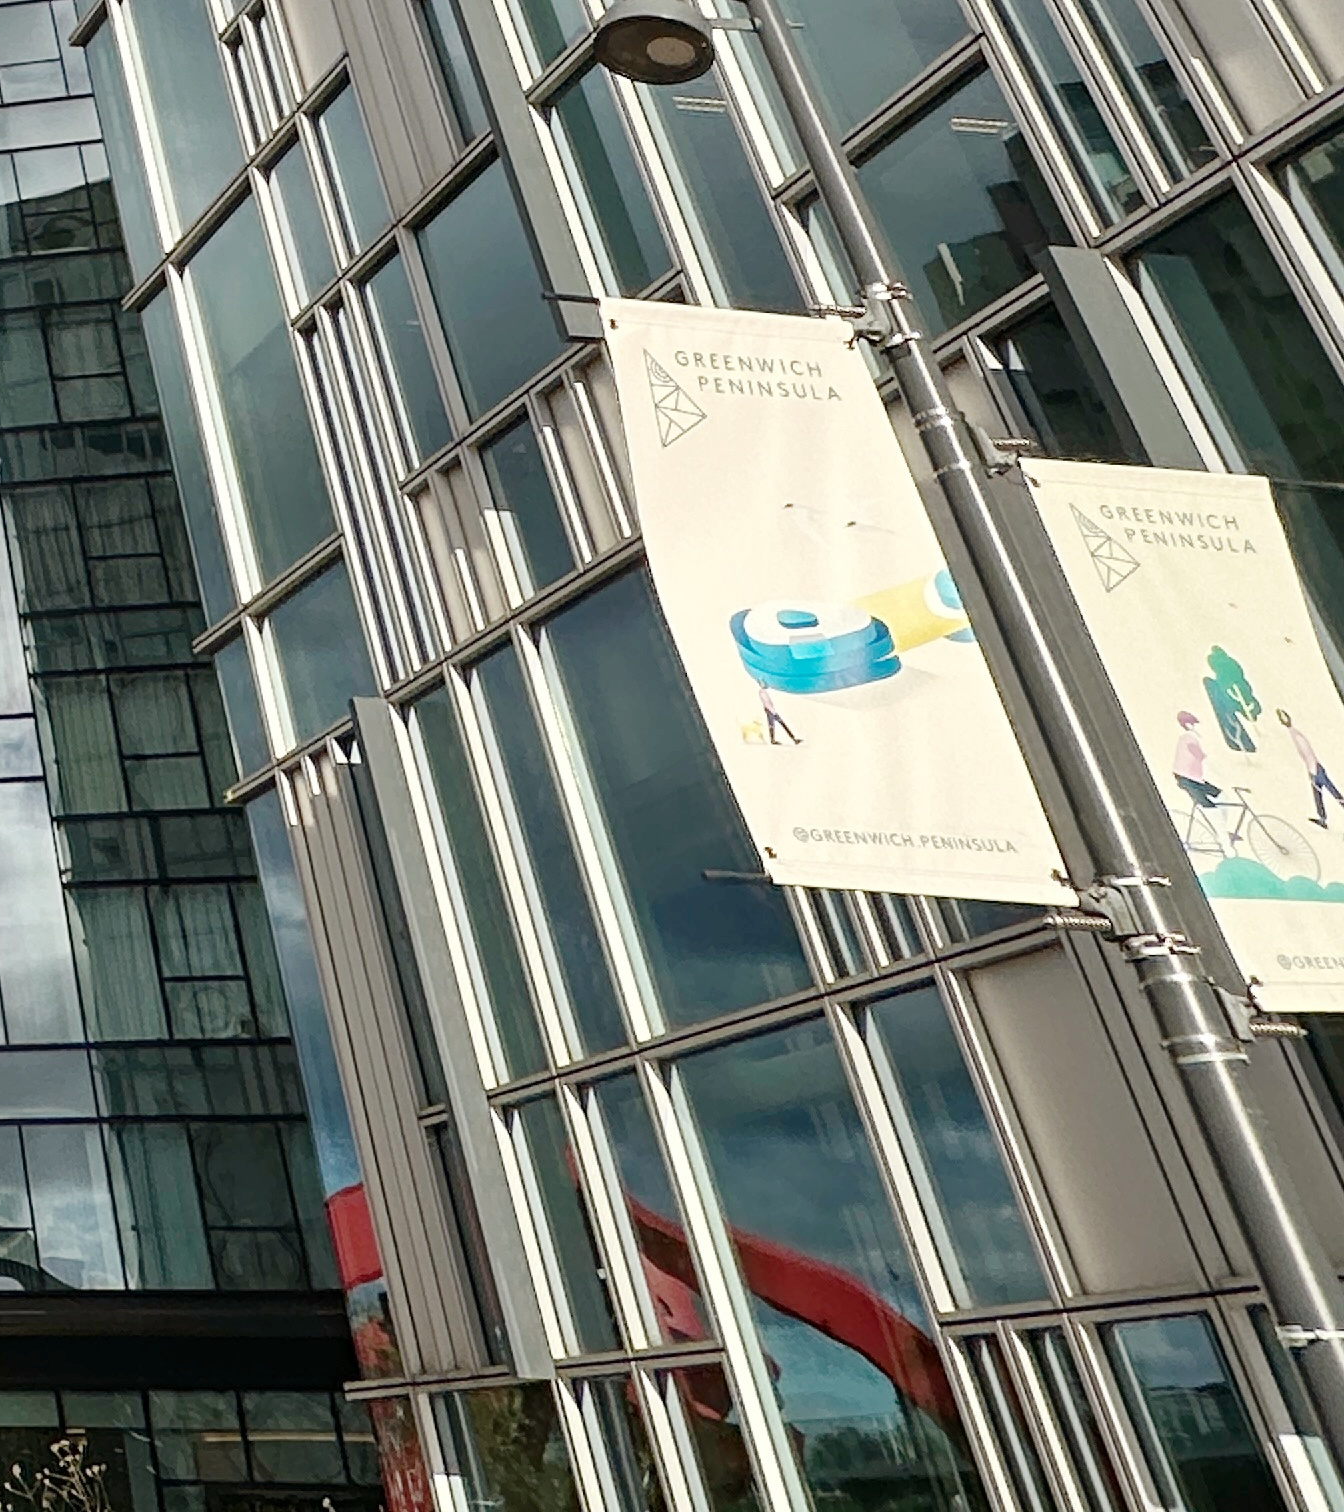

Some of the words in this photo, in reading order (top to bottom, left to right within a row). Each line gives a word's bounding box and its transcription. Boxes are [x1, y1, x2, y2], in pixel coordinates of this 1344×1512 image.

[674, 350, 823, 378] GREENWICH
[697, 375, 843, 401] PENINSULA
[1099, 504, 1240, 531] GREENWICH
[1124, 528, 1257, 554] PENINSULA
